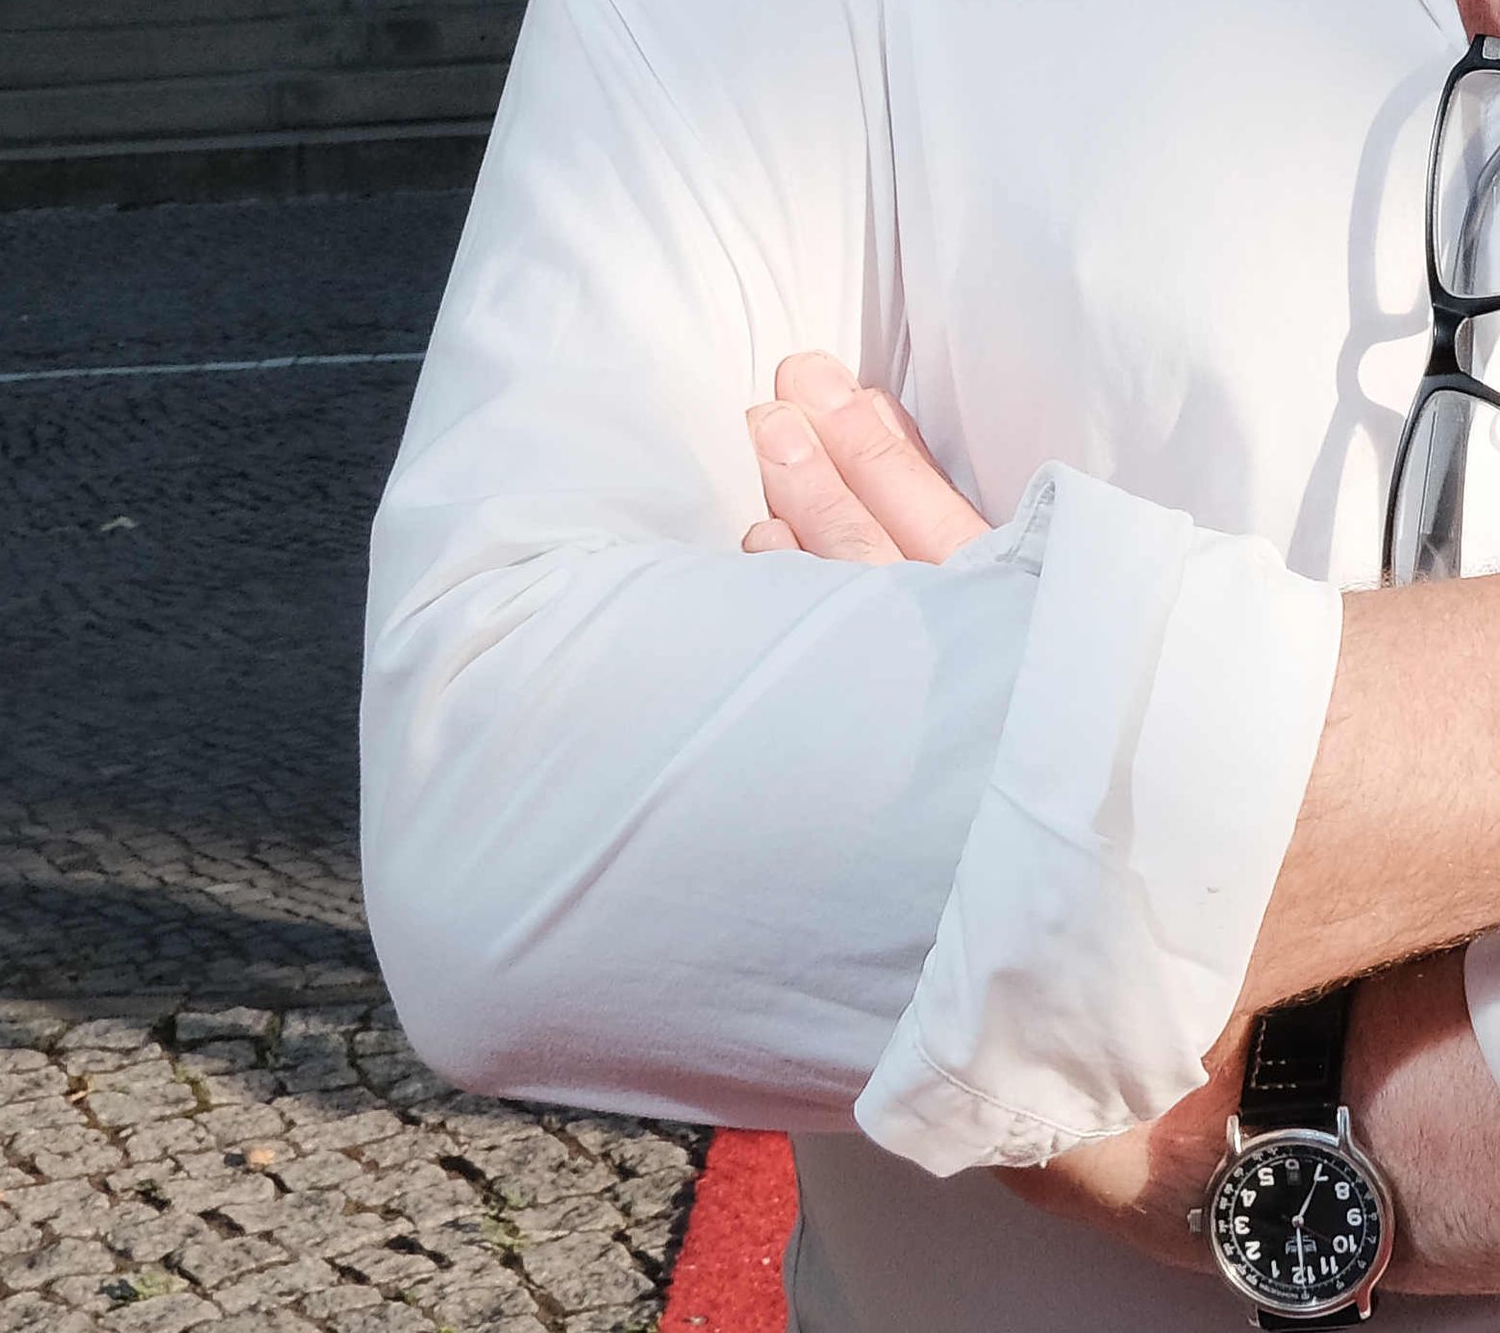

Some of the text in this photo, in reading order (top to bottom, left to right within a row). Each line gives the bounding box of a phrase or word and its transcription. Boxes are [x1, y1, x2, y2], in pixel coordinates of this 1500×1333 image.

[1257, 1167, 1275, 1186] 5
[1314, 1163, 1329, 1182] 7
[1240, 1188, 1257, 1208] 4
[1335, 1181, 1350, 1200] 8
[1234, 1216, 1251, 1235] 3
[1347, 1208, 1362, 1226] 9
[1245, 1241, 1261, 1260] 2
[1332, 1234, 1357, 1253] 10
[1271, 1259, 1280, 1278] 1
[1291, 1266, 1316, 1284] 12
[1319, 1256, 1339, 1275] 11
